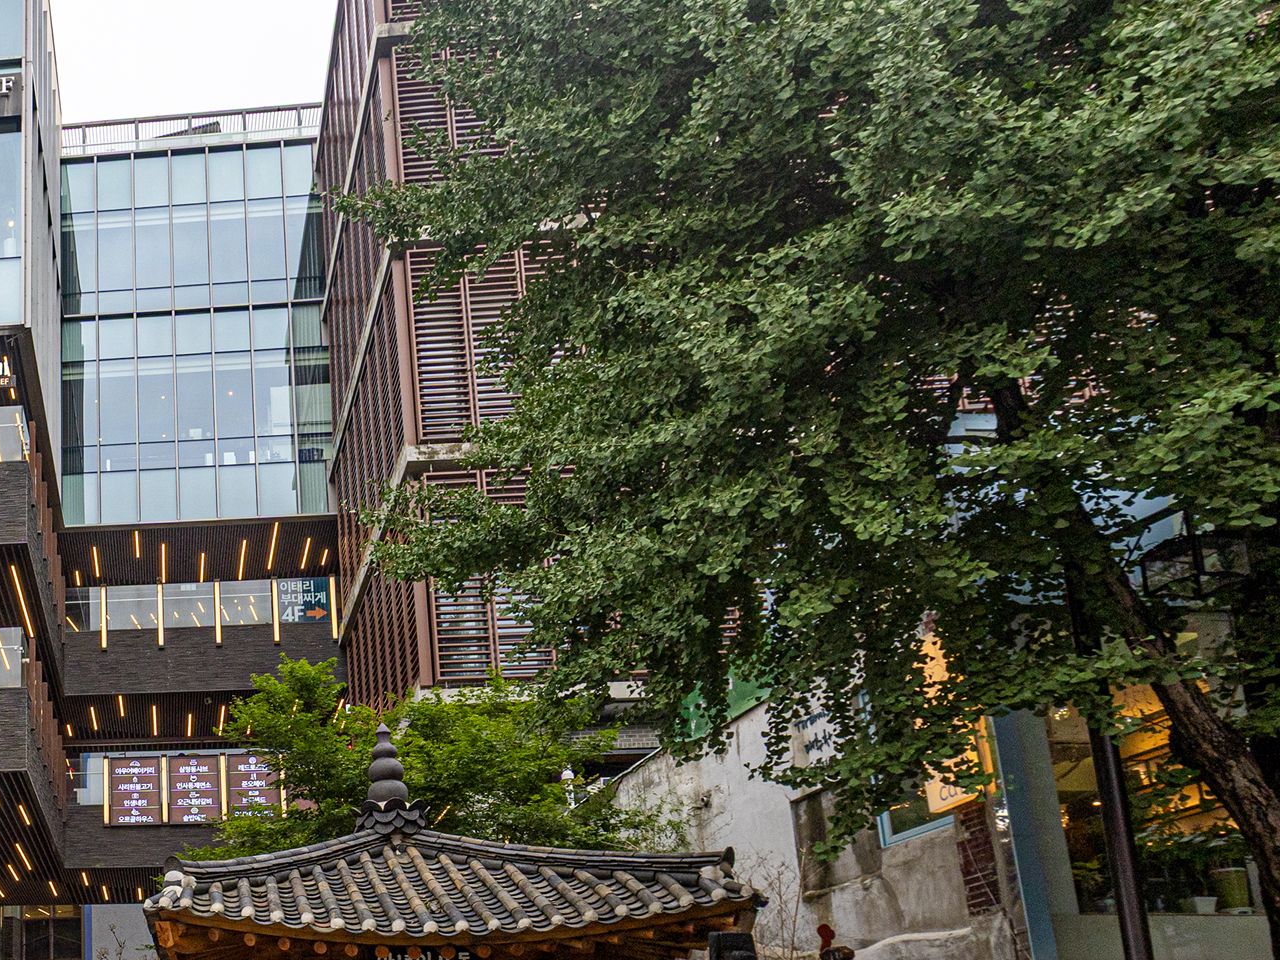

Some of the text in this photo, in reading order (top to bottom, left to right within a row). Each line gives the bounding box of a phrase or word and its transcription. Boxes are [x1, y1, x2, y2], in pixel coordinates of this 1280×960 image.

[280, 580, 314, 593] 이태리
[281, 605, 305, 623] 4F
[117, 782, 153, 791] 사리원불고기
